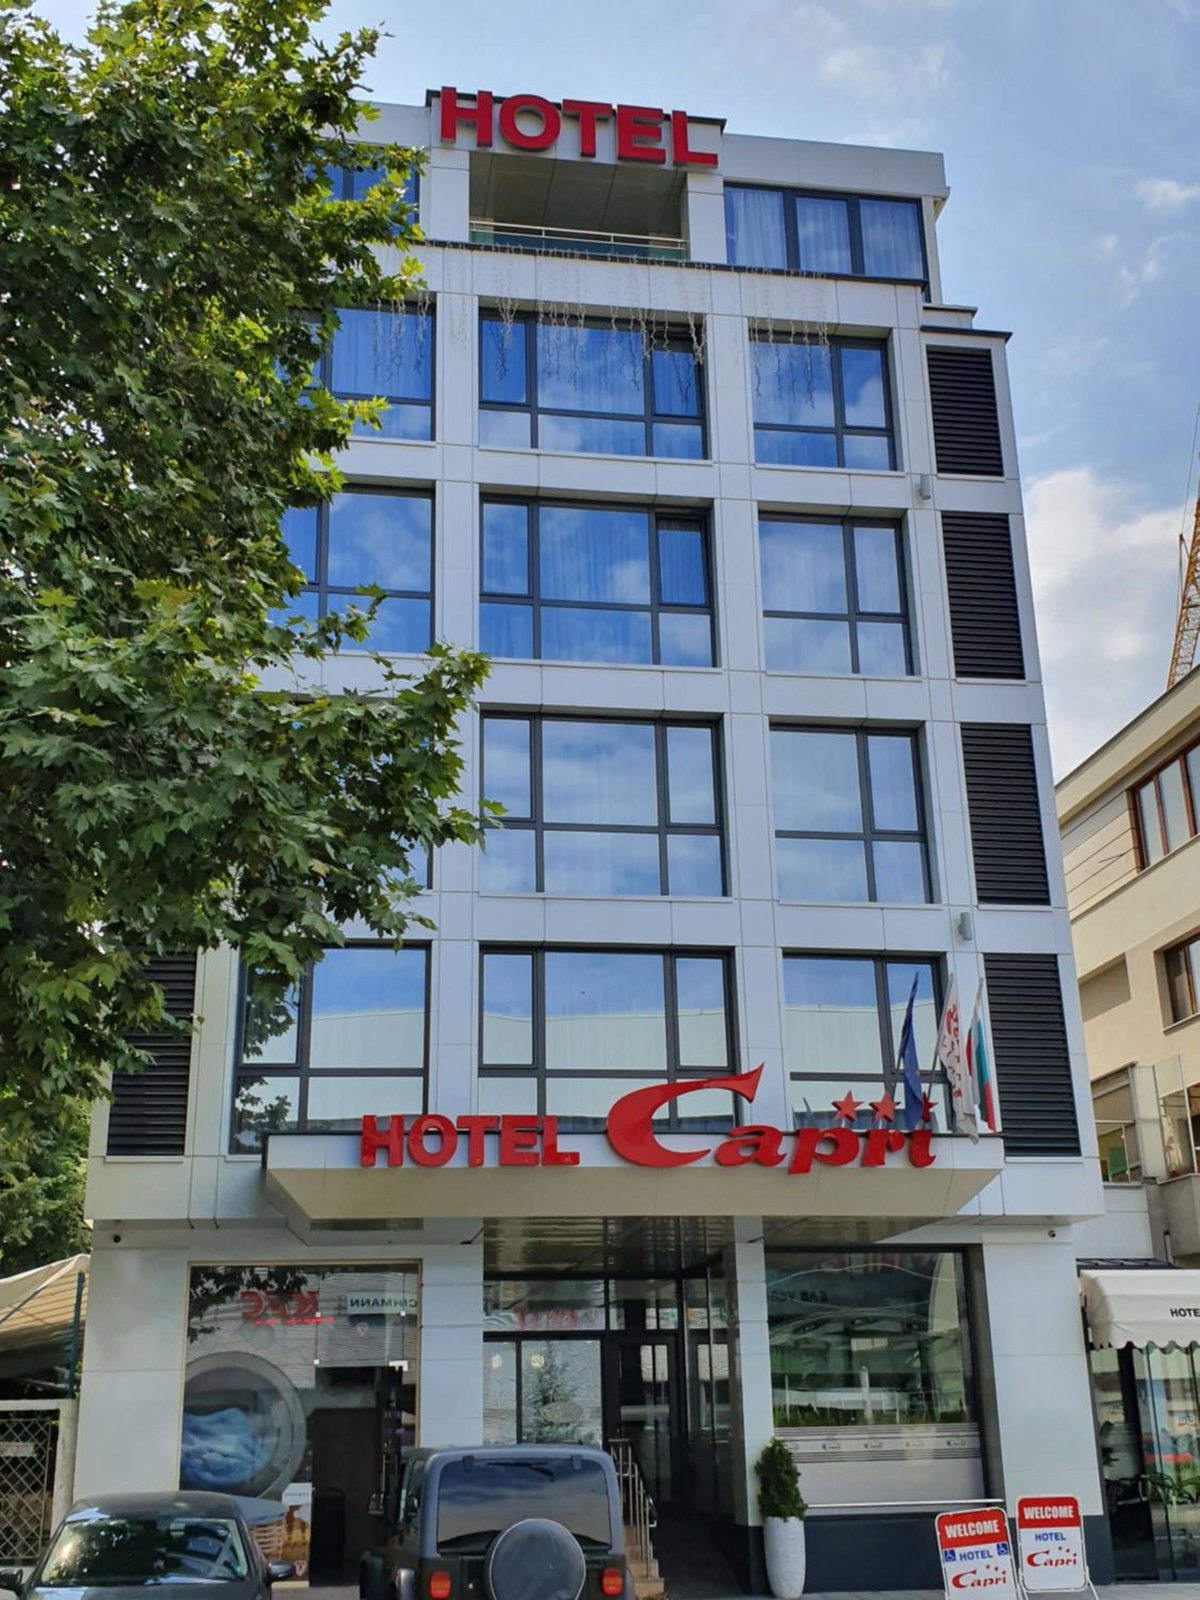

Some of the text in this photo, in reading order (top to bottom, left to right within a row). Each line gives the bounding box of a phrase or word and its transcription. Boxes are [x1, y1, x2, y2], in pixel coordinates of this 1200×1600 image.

[440, 86, 719, 169] HOTEL
[360, 1062, 936, 1175] HOTEL Capri
[1169, 1307, 1200, 1318] HOTE
[1023, 1505, 1074, 1520] WELCOME
[945, 1519, 1000, 1539] WELCOME
[1034, 1532, 1067, 1542] HOTEL
[959, 1549, 994, 1562] HOTEL
[1026, 1549, 1077, 1568] Capri
[951, 1568, 1007, 1590] Capri
